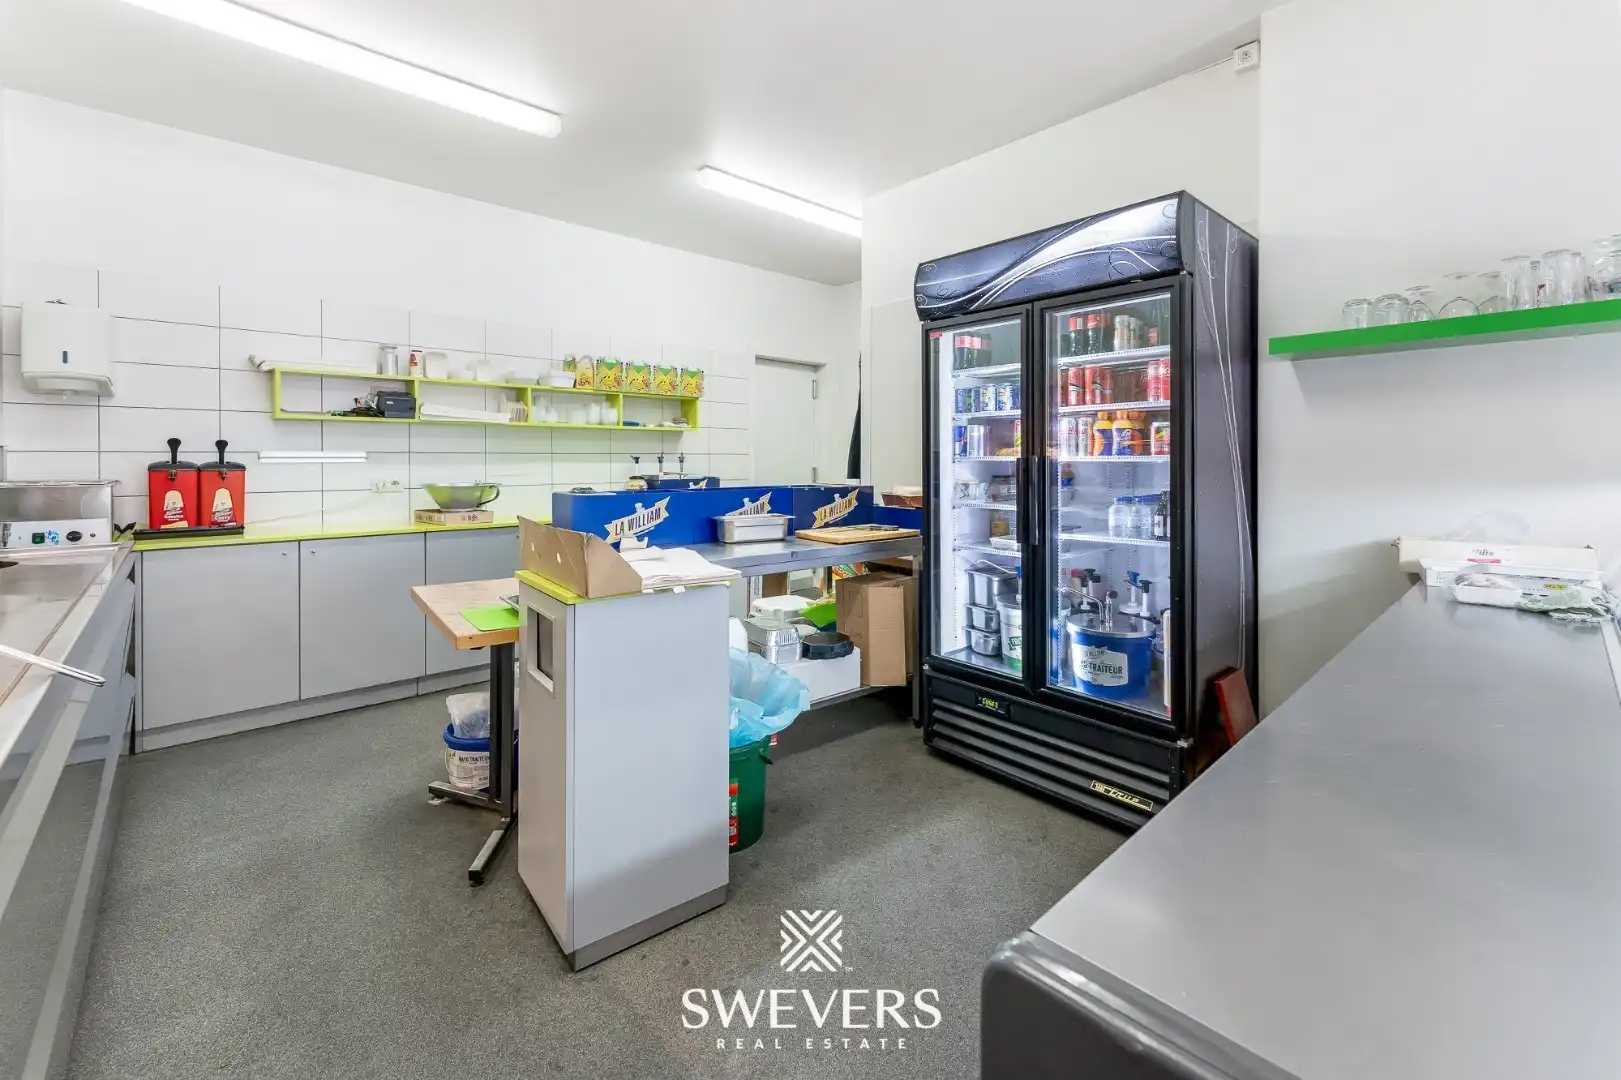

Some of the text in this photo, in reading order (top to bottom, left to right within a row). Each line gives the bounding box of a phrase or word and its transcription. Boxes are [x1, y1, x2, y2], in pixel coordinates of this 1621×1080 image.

[820, 497, 852, 521] LA WILLIAM
[615, 507, 661, 536] LA WILLIAM
[1089, 663, 1123, 675] TRAITEUR
